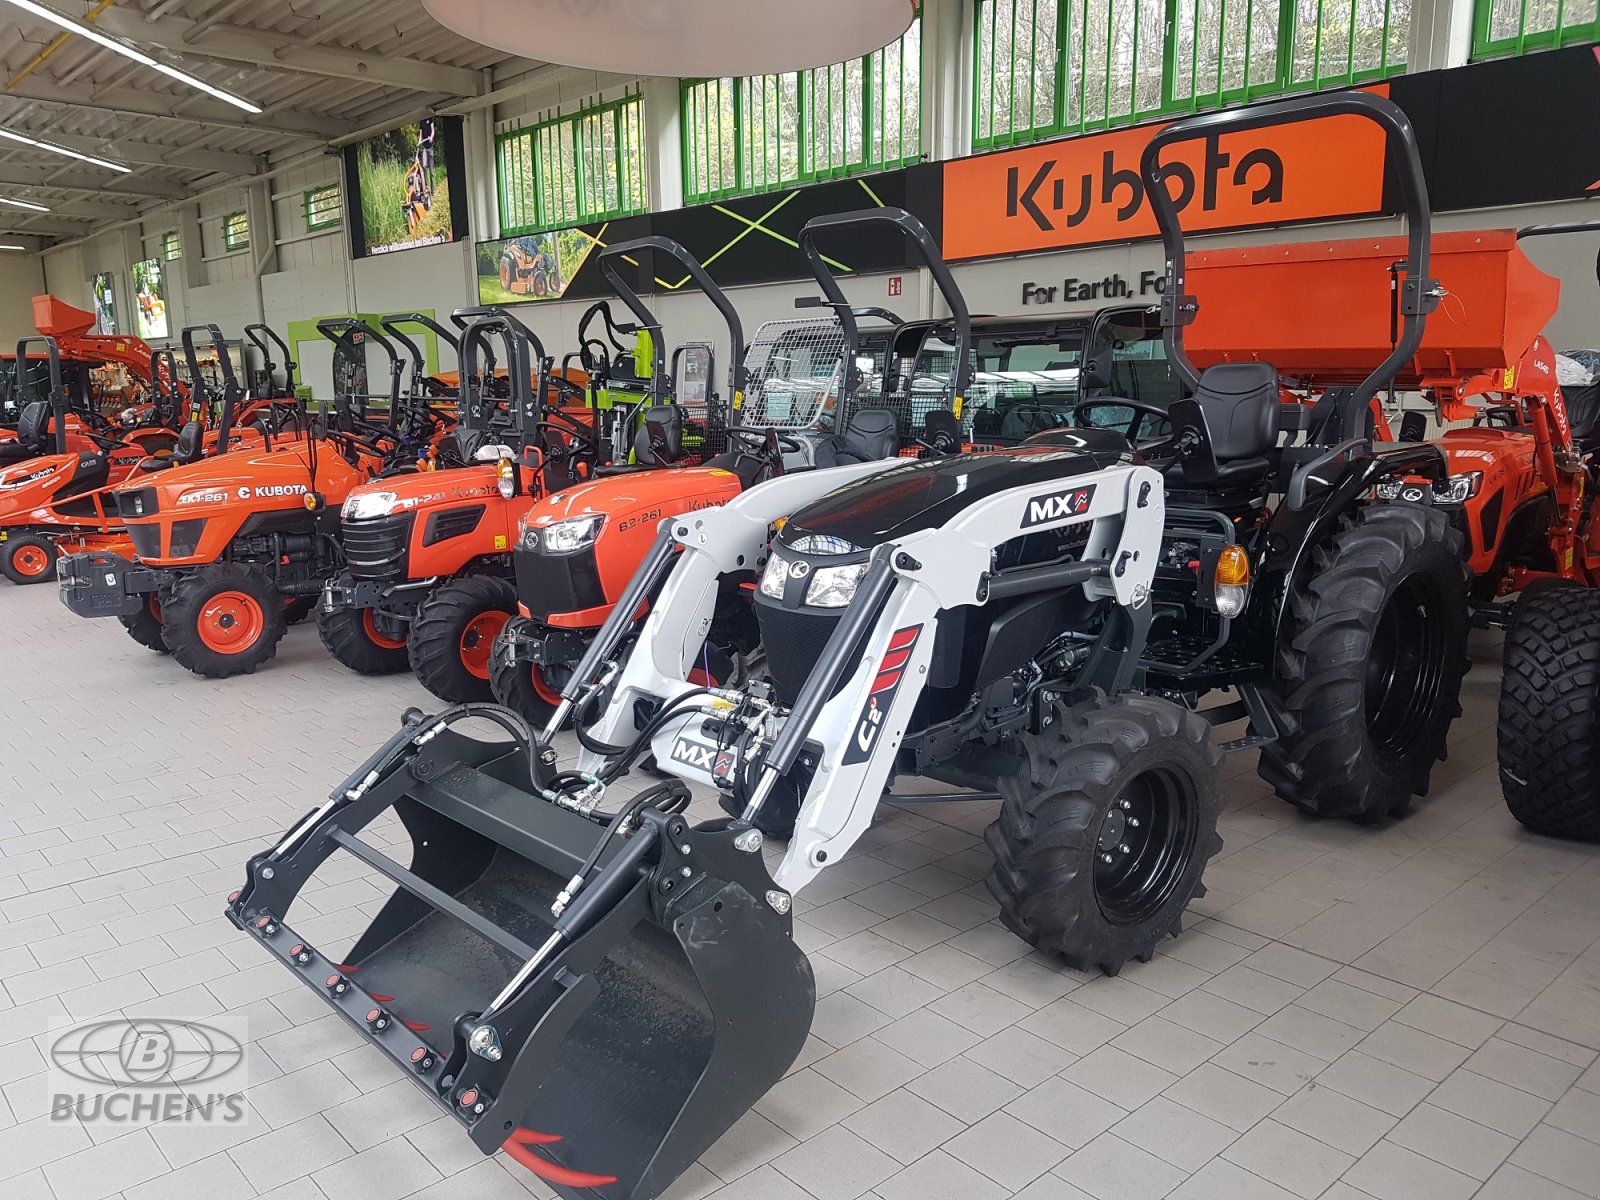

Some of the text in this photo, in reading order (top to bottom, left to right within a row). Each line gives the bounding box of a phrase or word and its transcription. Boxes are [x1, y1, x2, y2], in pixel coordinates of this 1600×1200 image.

[1006, 135, 1284, 231] Kubota
[1022, 282, 1057, 305] For
[1064, 273, 1134, 302] Earth,
[254, 484, 309, 497] KUBOTA
[618, 508, 662, 533] B2-261
[1029, 493, 1073, 523] MX
[673, 740, 718, 770] MX
